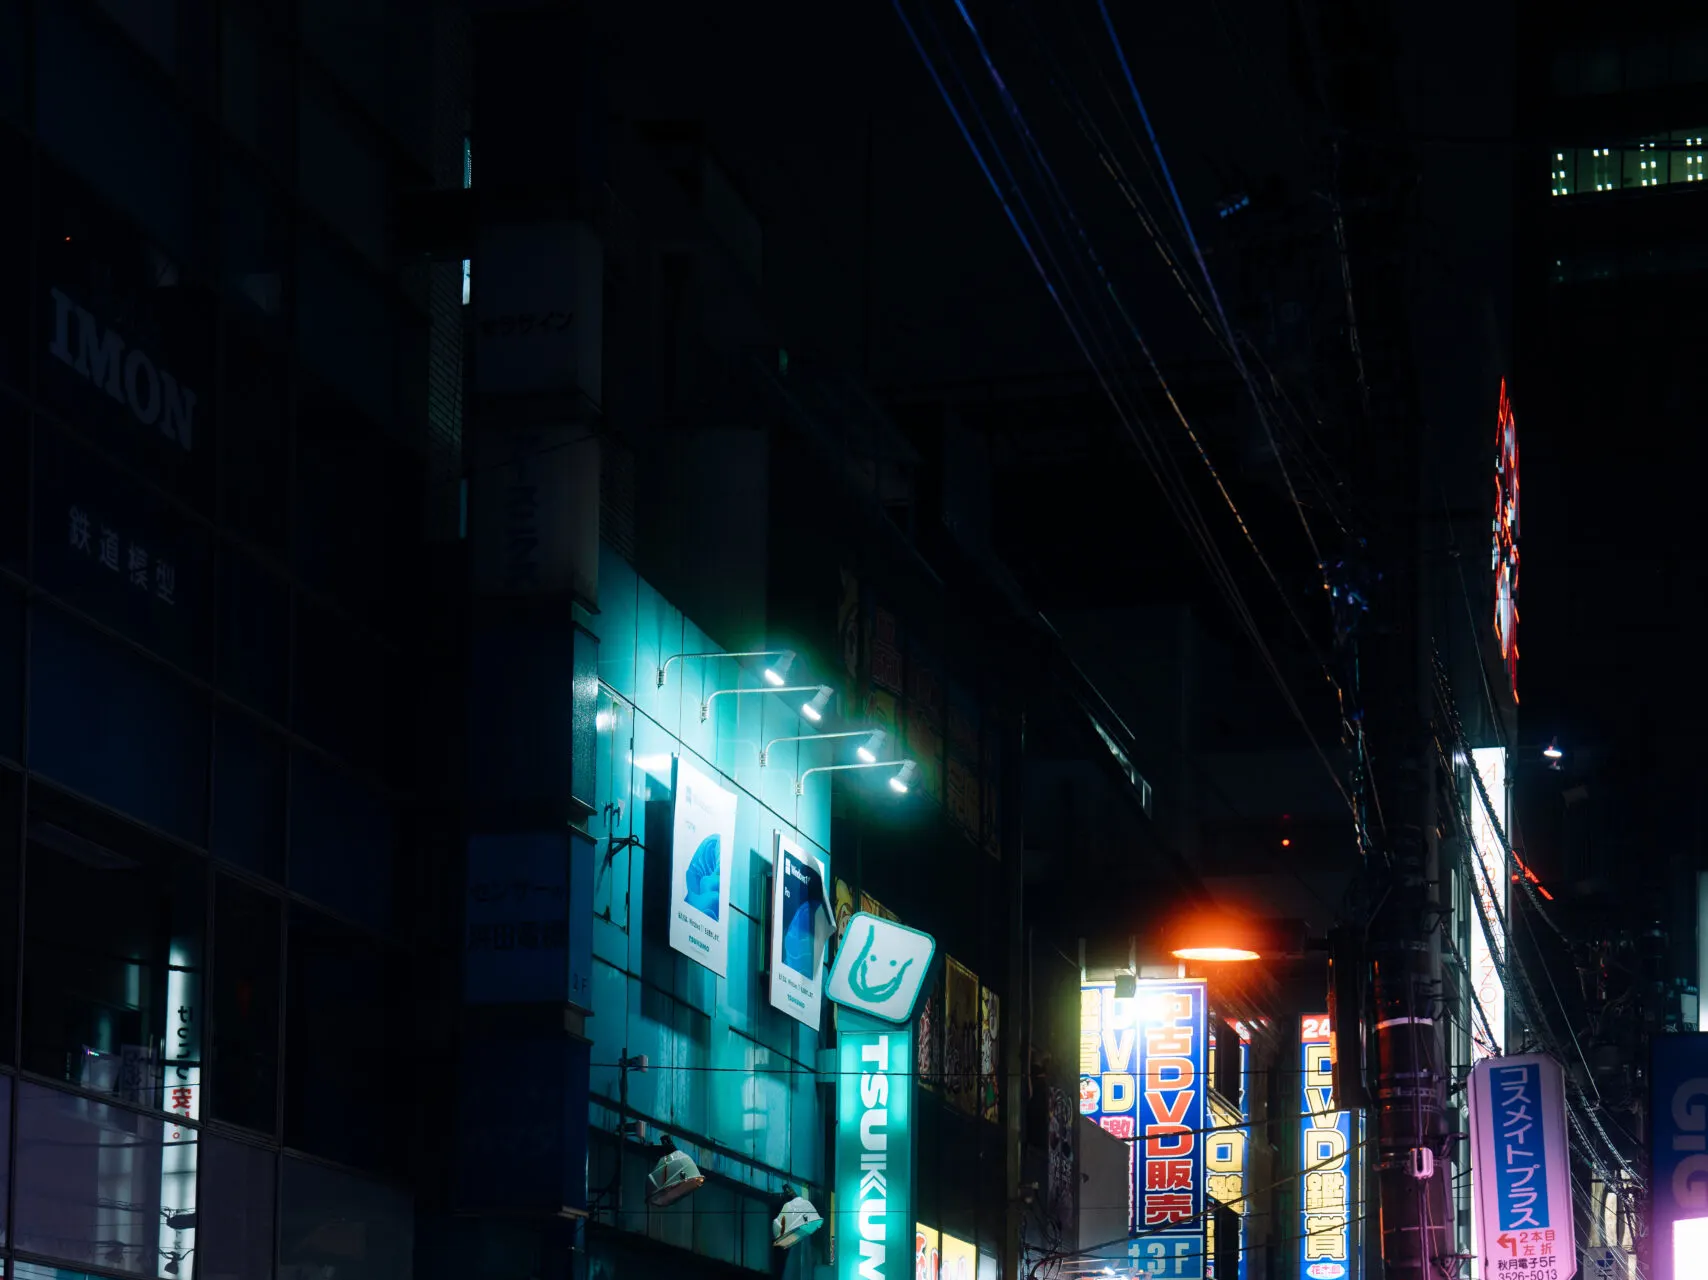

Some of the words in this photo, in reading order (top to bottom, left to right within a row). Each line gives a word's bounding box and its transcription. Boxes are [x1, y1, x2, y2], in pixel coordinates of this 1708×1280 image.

[49, 285, 197, 453] IMON
[67, 503, 176, 606] 鉄道模型
[1501, 1066, 1541, 1229] コスメイトプラス
[1497, 1256, 1556, 1271] 秋月電子5F
[1519, 1229, 1556, 1244] 2本目
